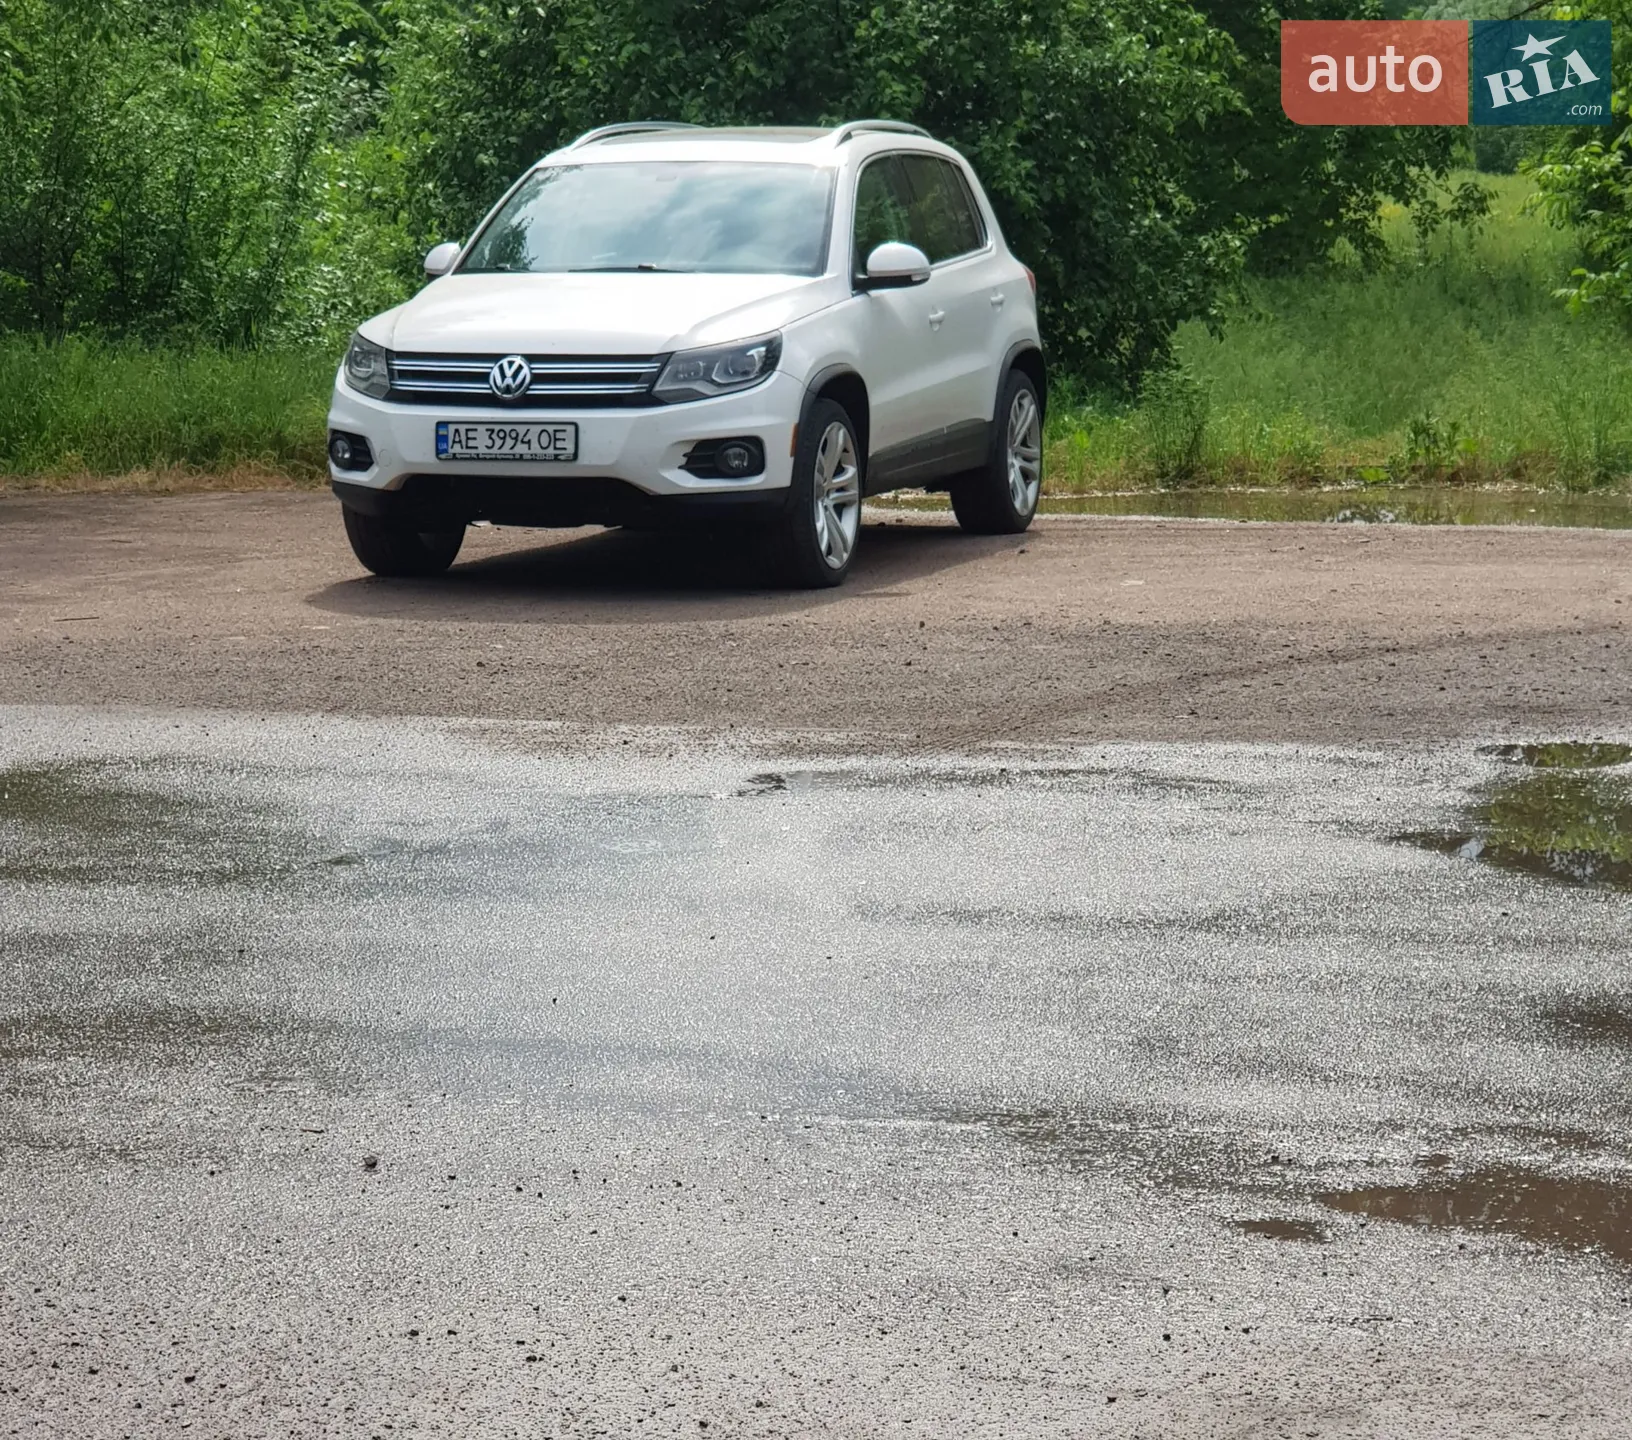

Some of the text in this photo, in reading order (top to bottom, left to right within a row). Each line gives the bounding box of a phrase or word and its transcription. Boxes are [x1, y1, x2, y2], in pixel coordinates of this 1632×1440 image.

[450, 428, 567, 450] AE 3994 OE
